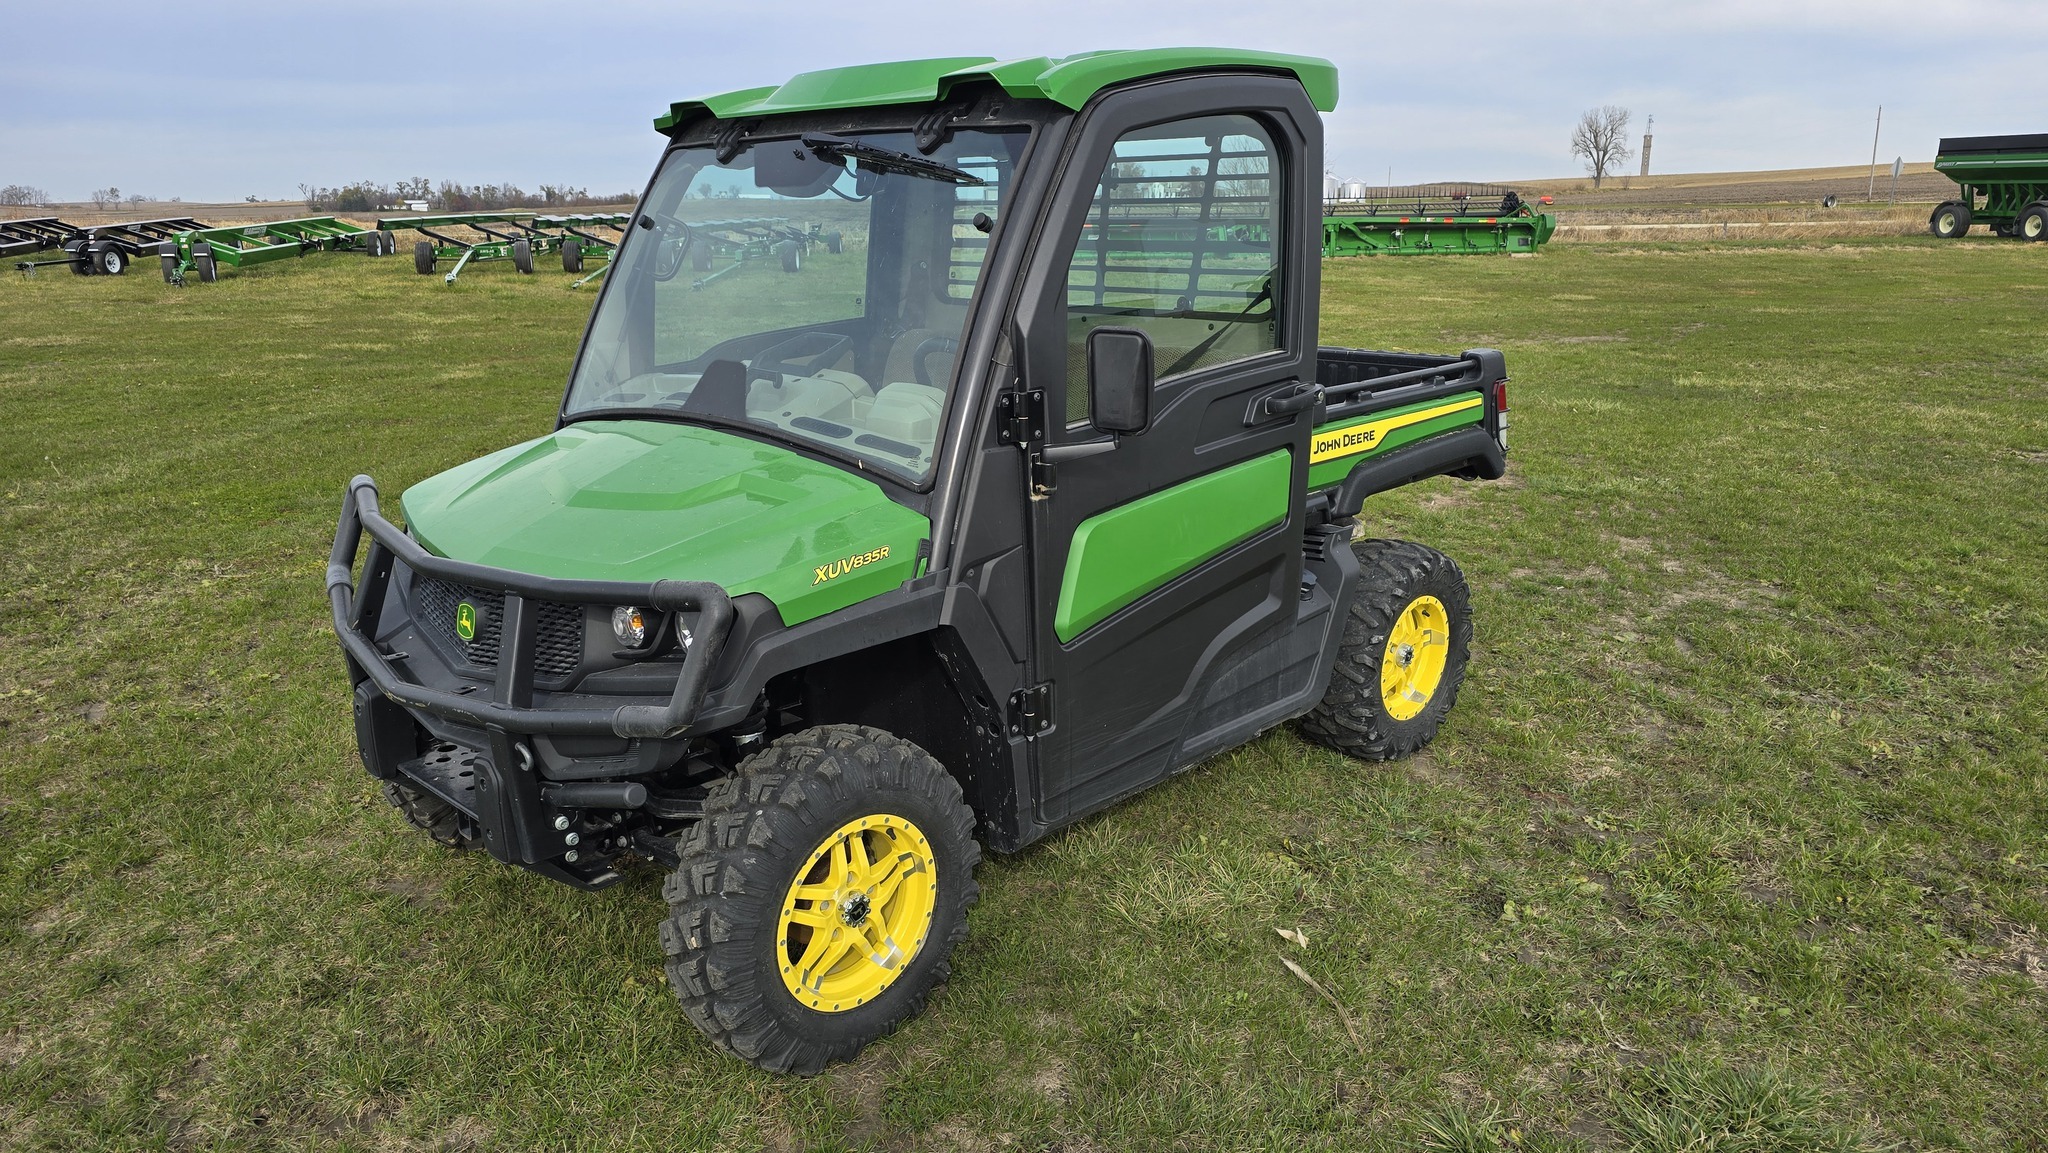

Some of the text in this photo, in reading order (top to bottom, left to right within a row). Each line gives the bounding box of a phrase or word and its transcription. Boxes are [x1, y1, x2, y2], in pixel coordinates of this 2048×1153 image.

[1313, 430, 1375, 455] JOHN DEERE
[812, 545, 890, 587] XUV835R
